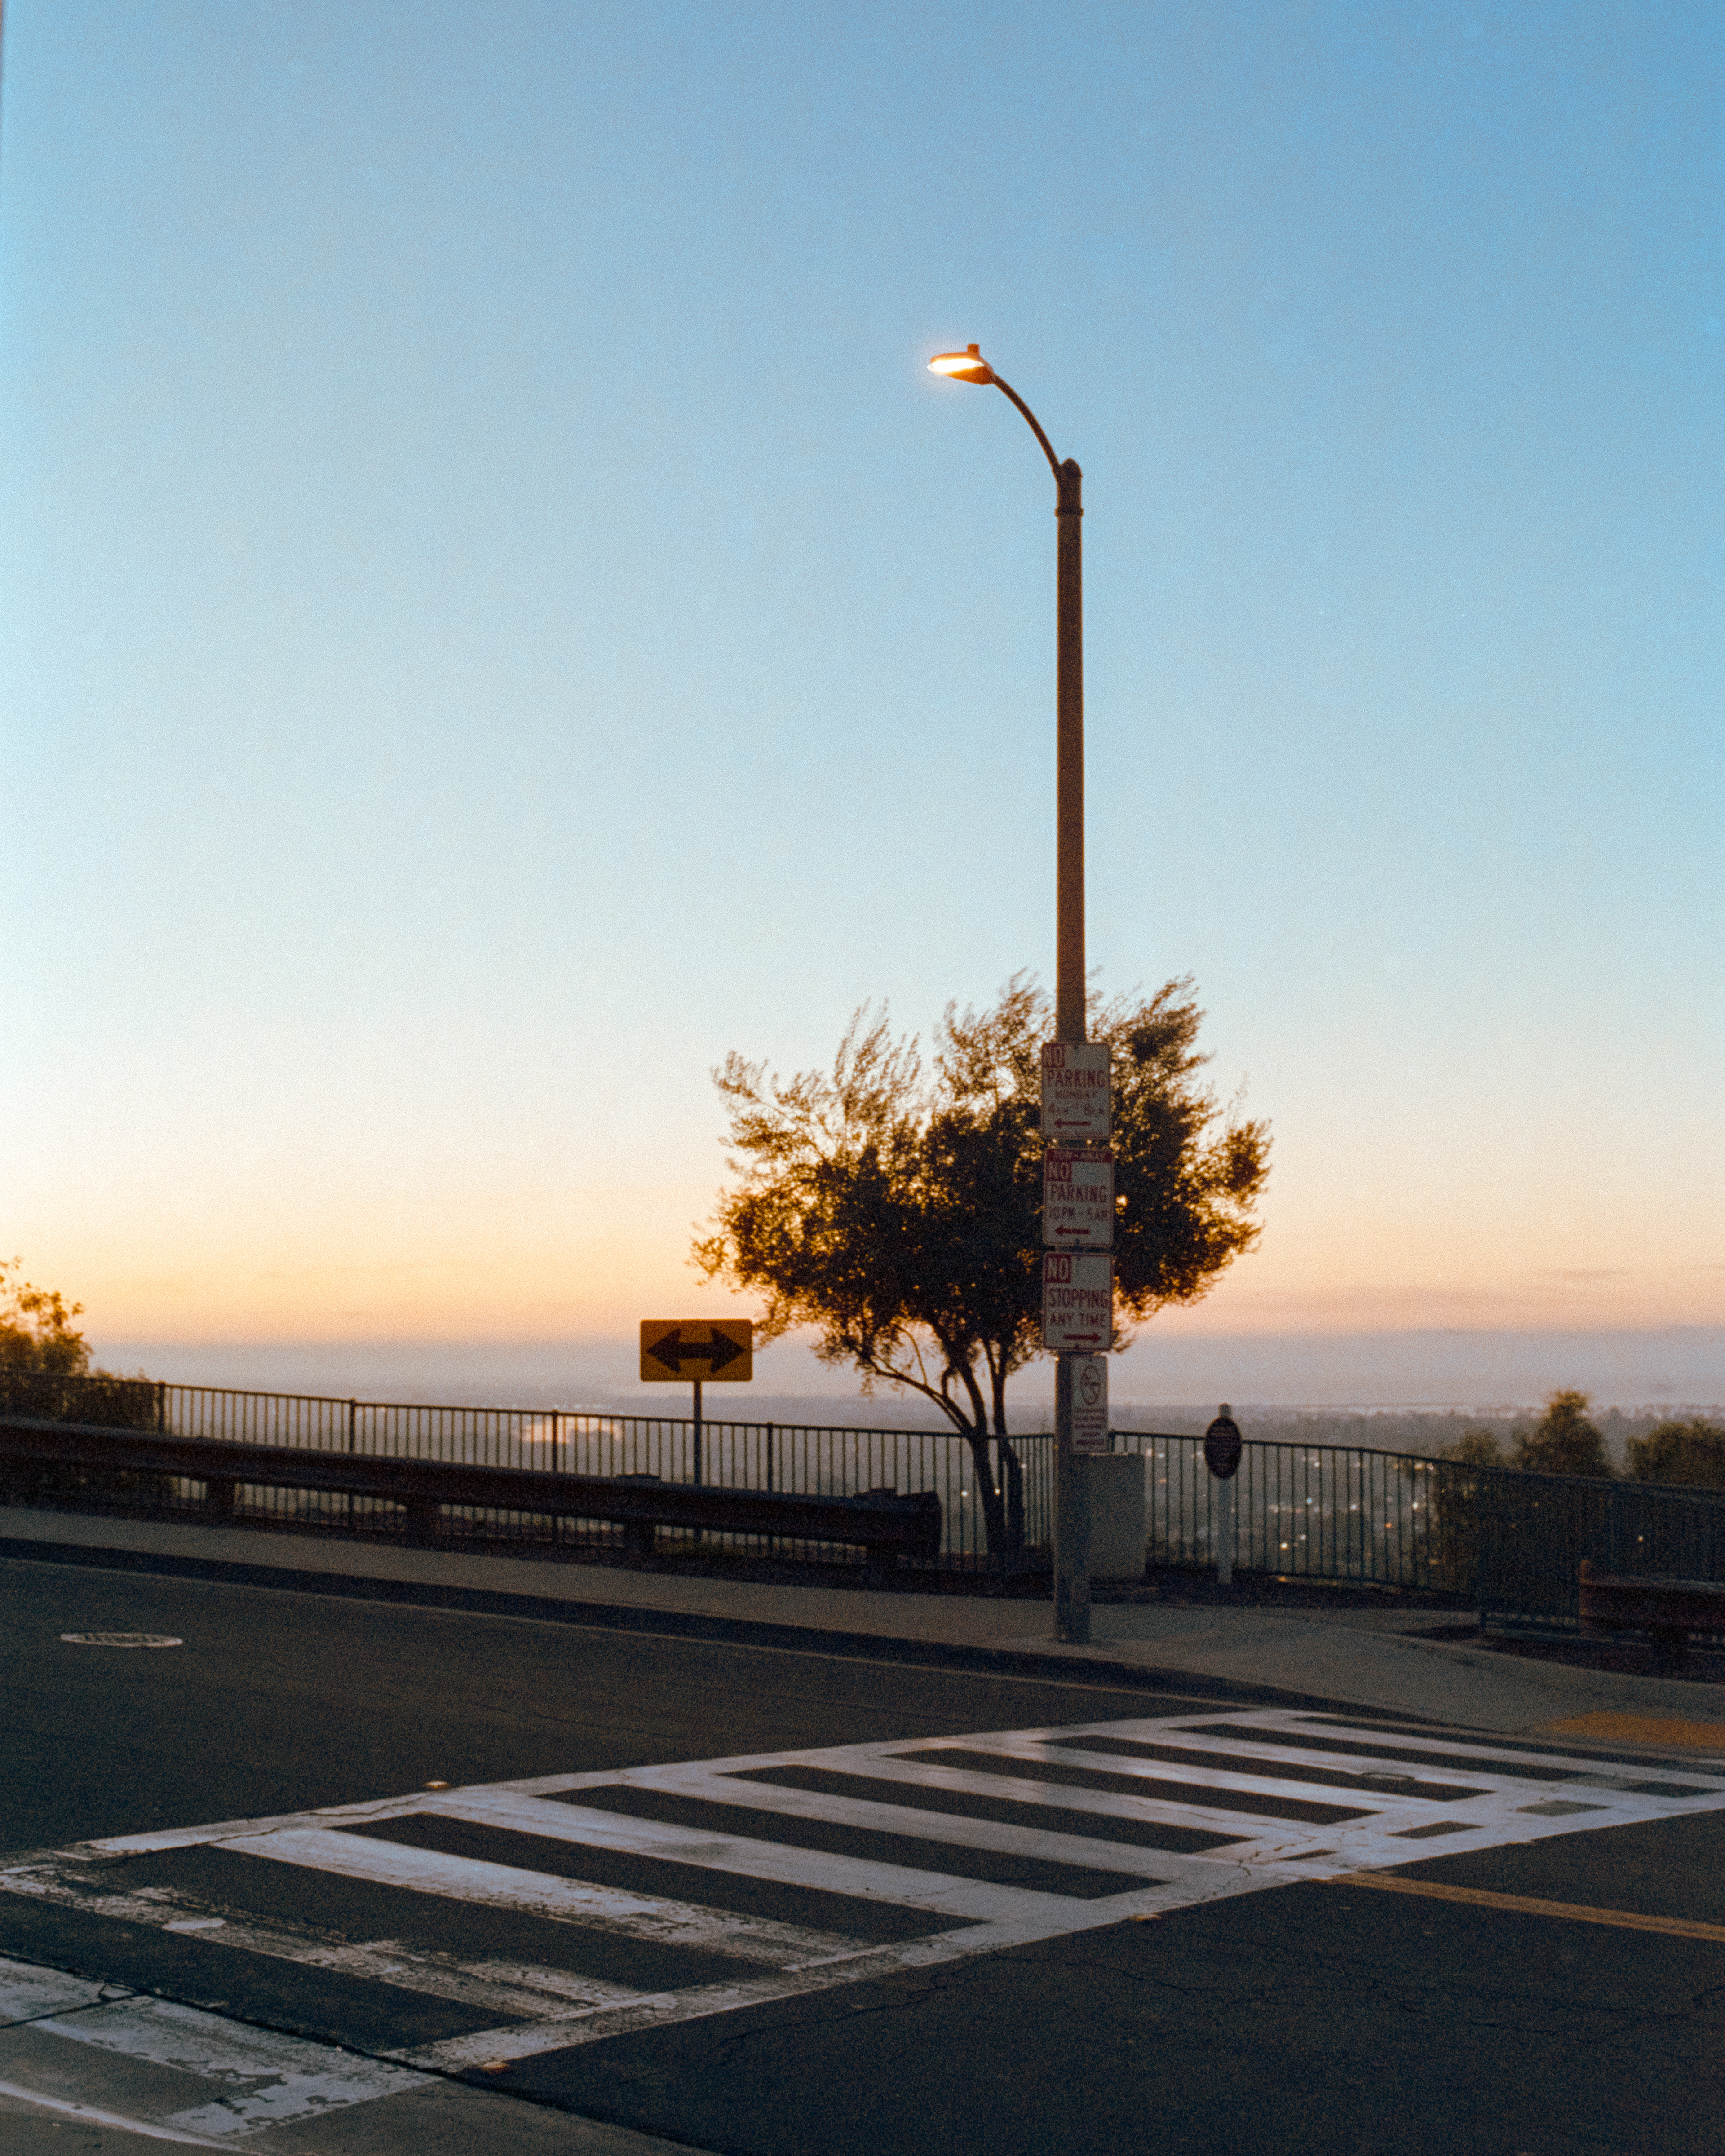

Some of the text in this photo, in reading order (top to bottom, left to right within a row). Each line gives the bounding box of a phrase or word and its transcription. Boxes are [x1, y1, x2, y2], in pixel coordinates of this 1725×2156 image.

[1043, 1046, 1062, 1066] NO
[1047, 1069, 1105, 1087] PARKING
[1048, 1162, 1070, 1180] NO
[1051, 1184, 1106, 1202] PARKING
[1048, 1257, 1069, 1280] NO
[1049, 1288, 1109, 1308] STOPPING
[1050, 1312, 1106, 1328] ANY TIME
